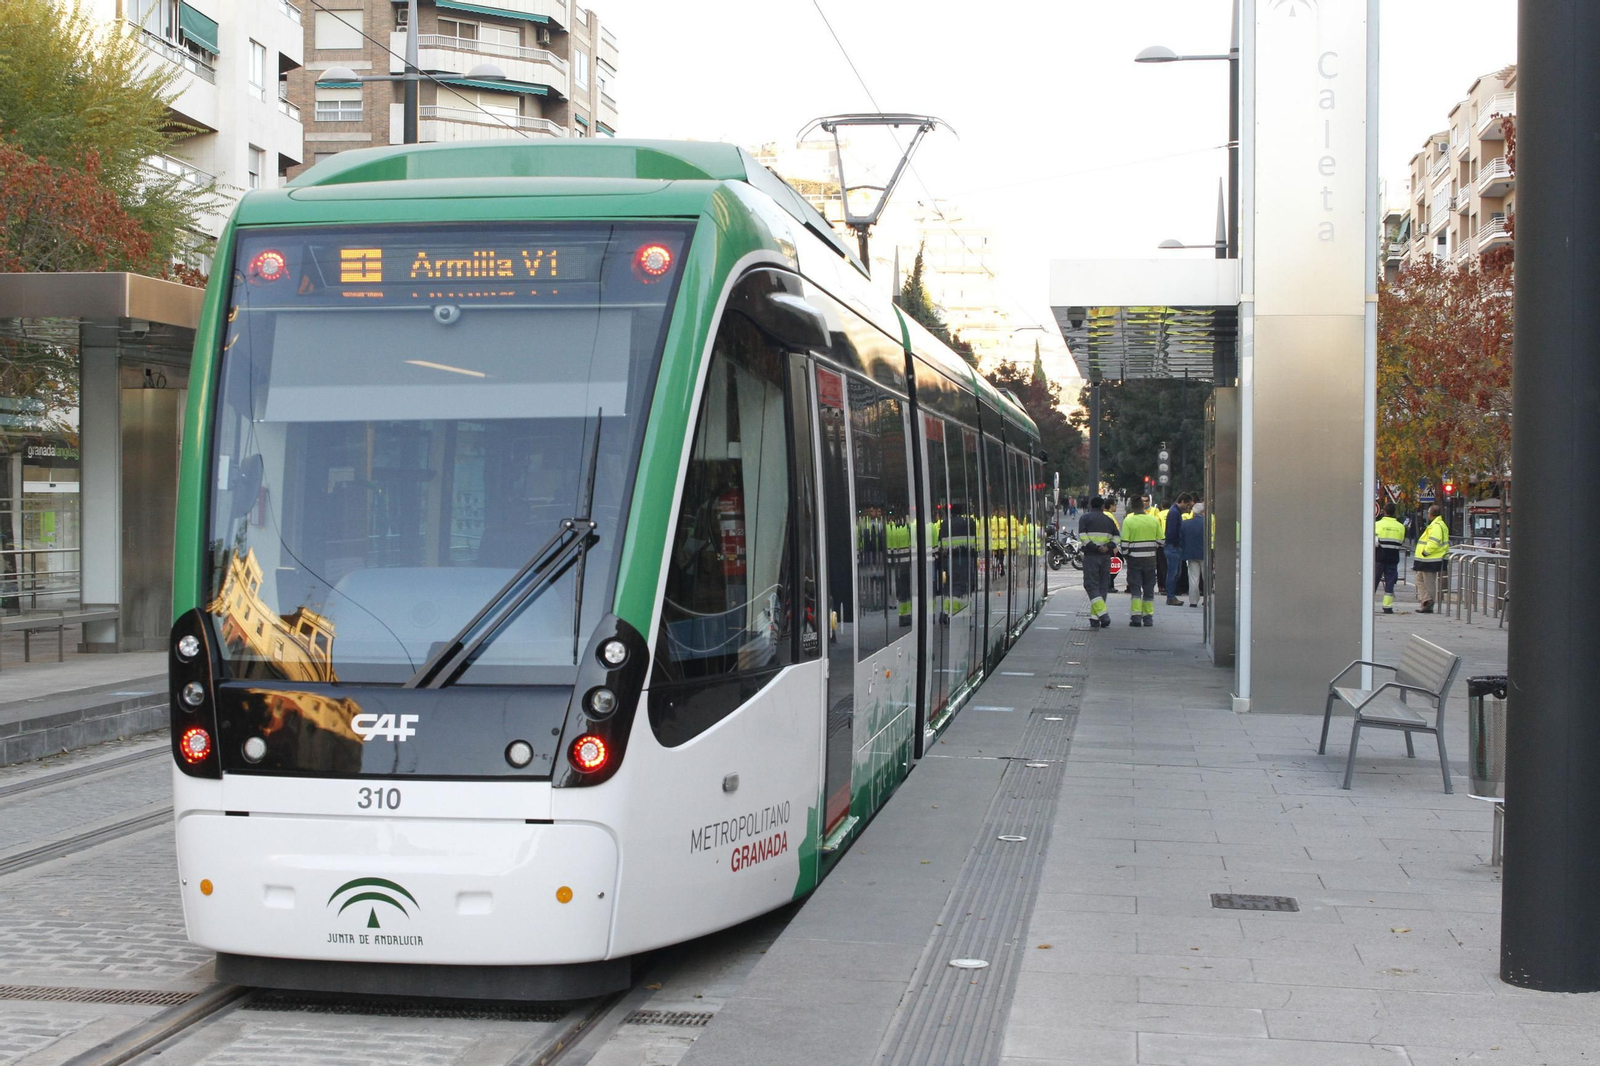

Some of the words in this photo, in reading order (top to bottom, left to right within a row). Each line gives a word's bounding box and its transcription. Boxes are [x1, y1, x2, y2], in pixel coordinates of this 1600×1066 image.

[1317, 51, 1339, 242] Caleta
[411, 251, 514, 278] Armilla
[521, 250, 557, 276] V1
[350, 713, 419, 742] CAF
[357, 787, 401, 810] 310
[690, 800, 791, 854] METROPOLITANO
[731, 830, 788, 872] GRANADA
[327, 933, 355, 944] JUNTA
[359, 934, 370, 944] DE
